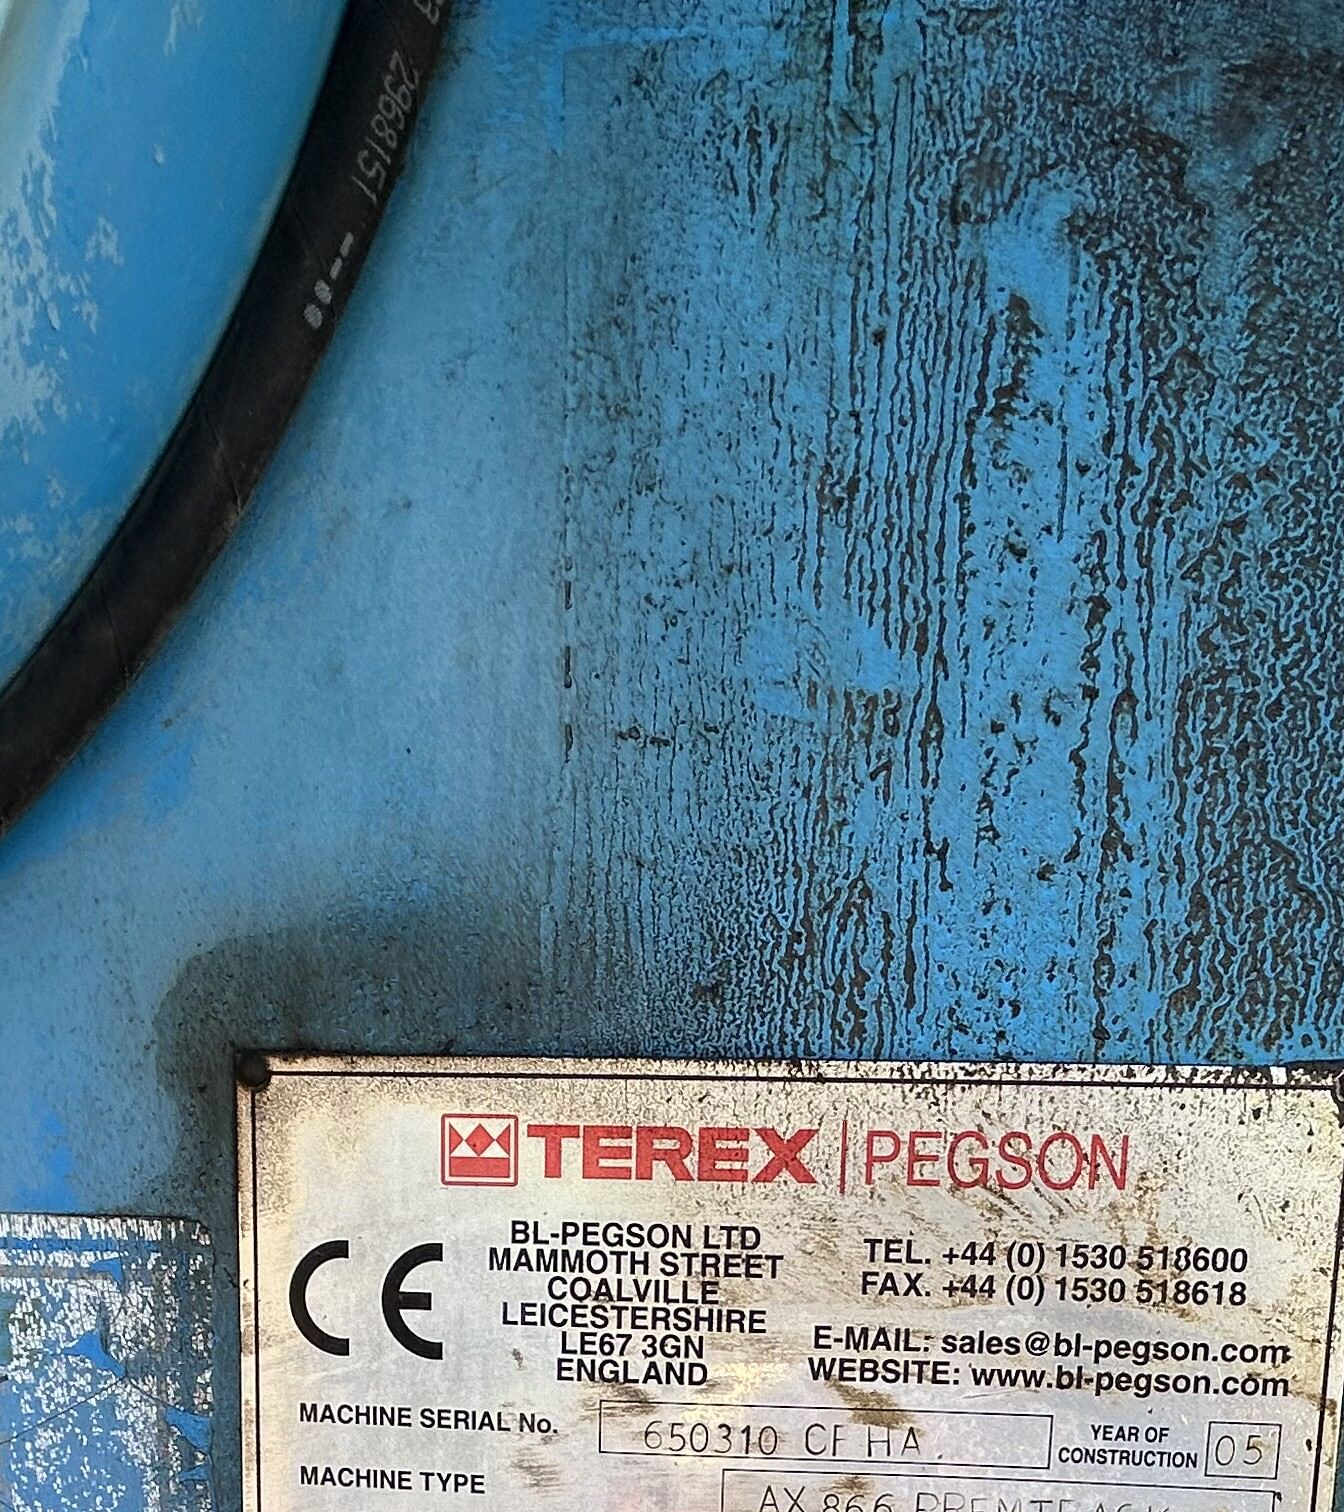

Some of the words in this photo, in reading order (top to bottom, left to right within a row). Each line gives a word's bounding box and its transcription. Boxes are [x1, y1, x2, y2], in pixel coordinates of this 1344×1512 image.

[527, 1124, 818, 1185] TEREX
[864, 1129, 1129, 1192] PEGSON
[510, 1220, 692, 1249] BL-PEGSON
[703, 1225, 761, 1251] LTD
[488, 1247, 650, 1276] MAMMOTH
[658, 1252, 784, 1280] STREET
[863, 1238, 932, 1266] TEL.
[942, 1240, 997, 1267] +44
[1005, 1241, 1046, 1274] (0)
[1057, 1243, 1127, 1271] 1530
[1136, 1245, 1249, 1274] 518600
[546, 1276, 720, 1305] COALVILLE
[860, 1270, 932, 1298] FAX.
[942, 1274, 996, 1300] +44
[1005, 1274, 1045, 1306] (0)
[1055, 1276, 1126, 1303] 1530
[1135, 1279, 1247, 1307] 518618
[501, 1302, 768, 1334] LEICESTERSHIRE
[560, 1331, 632, 1358] LE67
[641, 1334, 705, 1360] 3GN
[812, 1325, 932, 1354] E-MAIL:
[940, 1331, 1290, 1365] sales@bl-pegson.com
[556, 1359, 708, 1386] ENGLAND
[808, 1357, 961, 1387] WEBSITE:
[971, 1364, 1290, 1400] www.bl-pegson.com
[299, 1403, 412, 1428] MACHINE
[419, 1408, 512, 1432] SERIAL
[519, 1413, 559, 1434] No.
[1090, 1423, 1139, 1443] YEAR
[1144, 1426, 1170, 1444] OF
[643, 1419, 779, 1457] 650310
[1214, 1434, 1265, 1467] 05
[1058, 1446, 1198, 1469] CONSTRUCTION
[299, 1465, 413, 1490] MACHINE
[419, 1471, 486, 1494] TYPE
